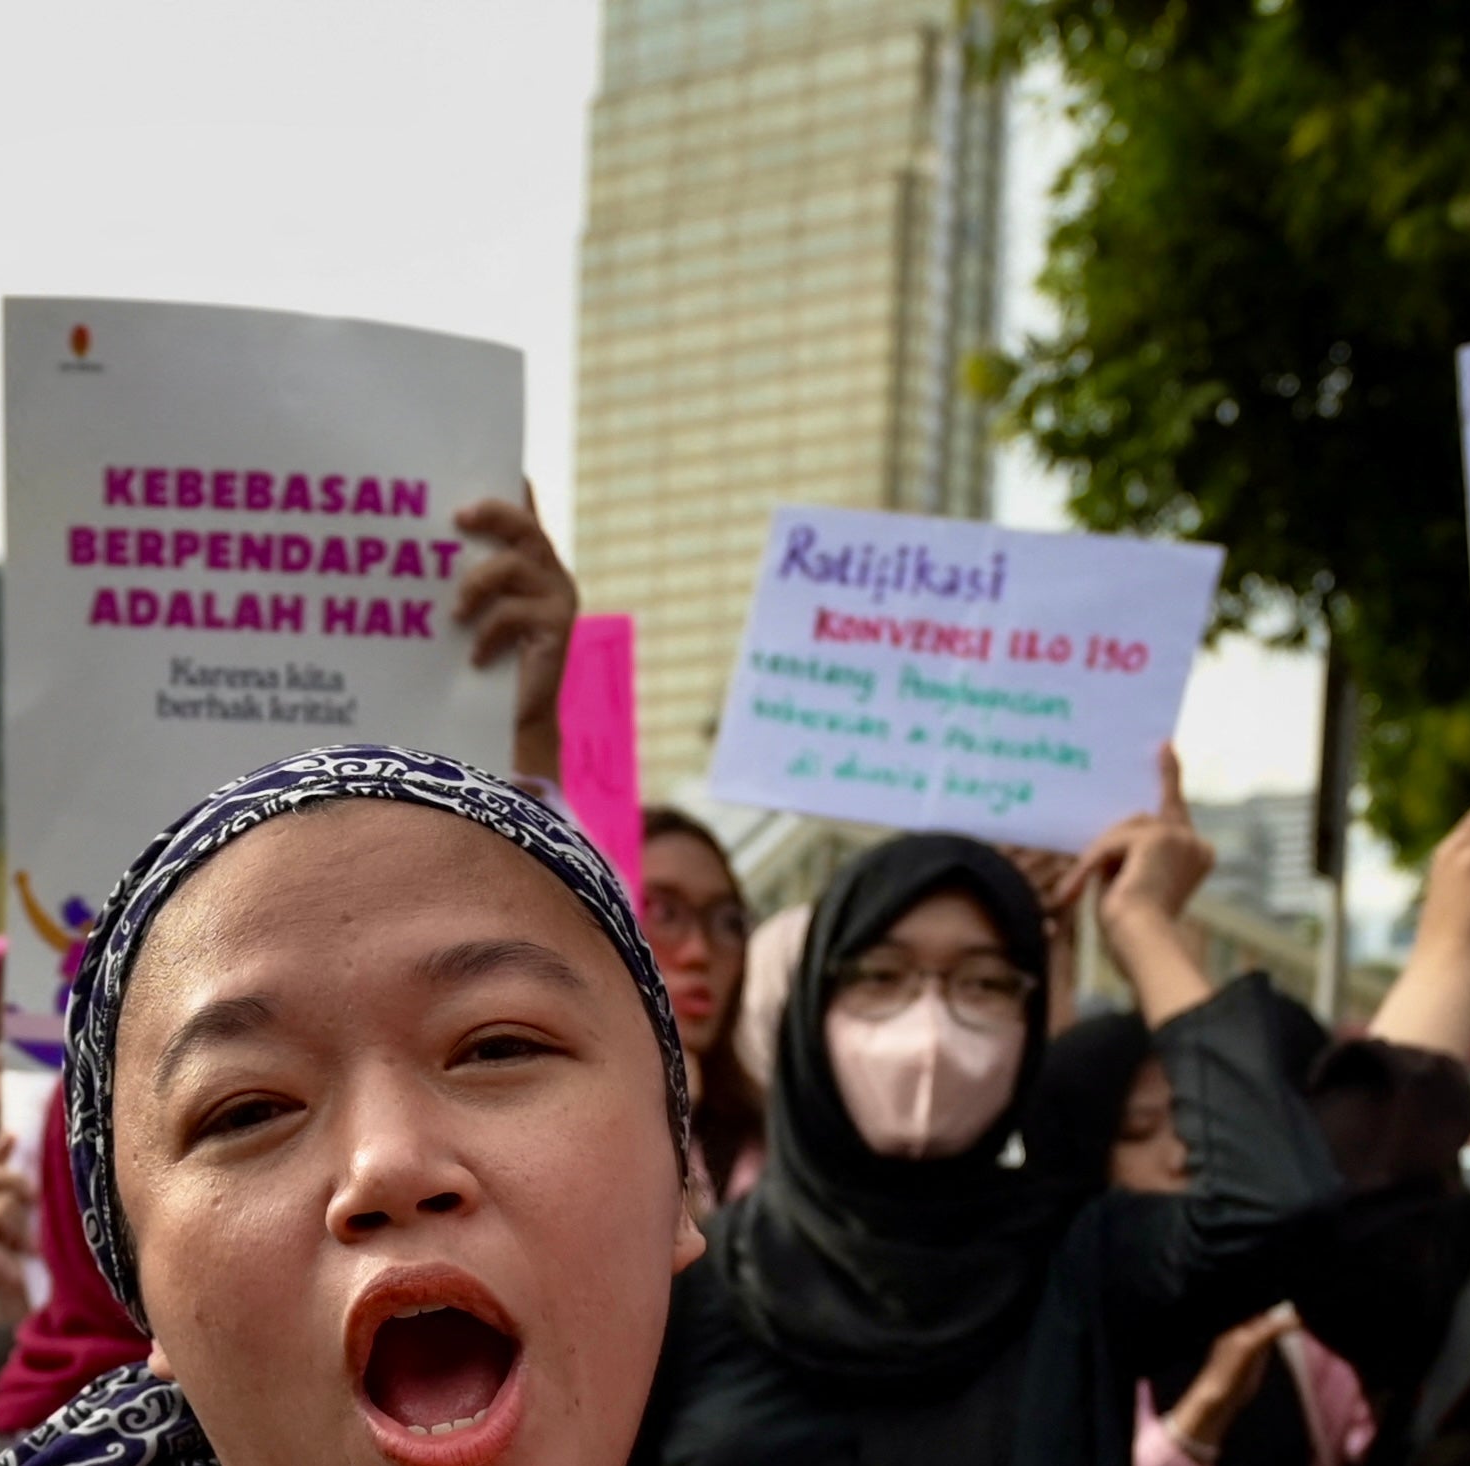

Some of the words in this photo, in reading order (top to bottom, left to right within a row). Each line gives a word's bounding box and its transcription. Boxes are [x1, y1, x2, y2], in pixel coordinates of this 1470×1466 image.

[103, 466, 428, 518] KEBEBASAN
[67, 526, 463, 579] BERPENDAPAT
[778, 524, 1006, 604] Ratifikasi
[87, 588, 304, 633] ADALAH
[322, 597, 434, 639] HAK
[812, 605, 992, 662] KONVENSI
[1008, 628, 1073, 664] ILO
[169, 656, 279, 689] Karena
[285, 661, 345, 692] kita
[156, 689, 263, 721] berhak
